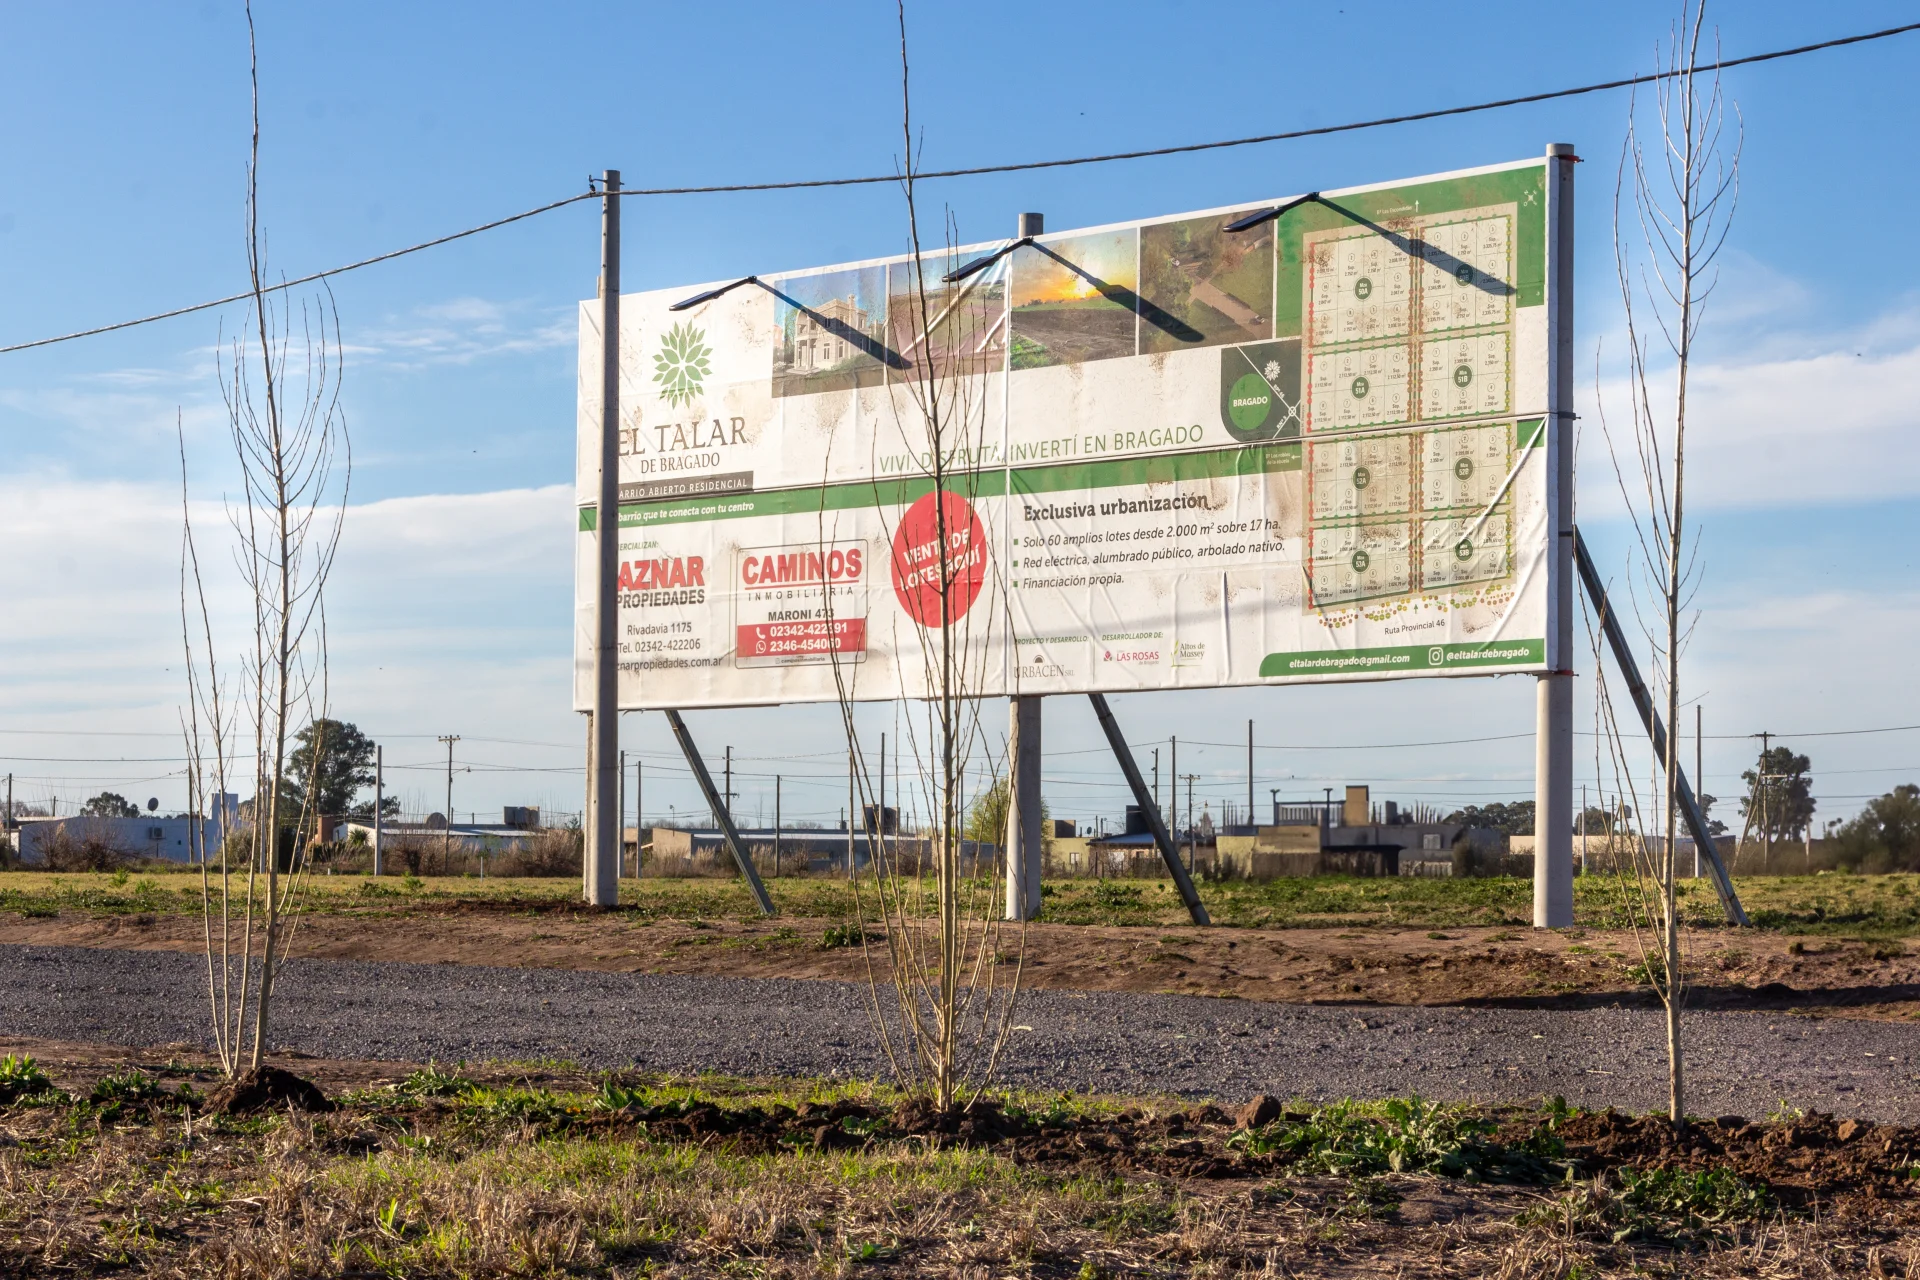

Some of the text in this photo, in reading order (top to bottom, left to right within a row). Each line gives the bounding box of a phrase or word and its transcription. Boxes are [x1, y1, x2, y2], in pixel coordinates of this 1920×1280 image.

[1233, 396, 1268, 408] BRAGADO
[618, 416, 748, 457] EL TALAR
[880, 424, 1203, 472] VIVÍ, DSFRUTÁ, INVERTÍ EN BRAGADO
[641, 452, 720, 474] DE BRAGADO
[619, 478, 748, 499] ARRIO ABIERTO RESIDENCIAL
[618, 502, 754, 524] barrio que te conecta con tu centro
[1024, 492, 1210, 522] Exclusiva urbanización
[1023, 518, 1281, 549] Solo 60 amplios lotes desde 2.000 m² sobre 17 ha.
[618, 540, 659, 550] ERCIALIZAN:
[903, 528, 970, 566] VENT DE
[1023, 540, 1285, 570] Red eléctrica, alumbrado público, arbolado nativo.
[618, 556, 705, 592] AZNAR
[742, 548, 862, 584] CAMINOS
[901, 564, 942, 592] LOTES
[1023, 572, 1124, 590] Financiación propia.
[618, 589, 706, 608] PROPIEDADES
[748, 586, 854, 601] INMOBILIARIA
[768, 608, 834, 622] MARONI 473
[628, 622, 692, 636] Rivadavia 1175
[1384, 618, 1445, 635] Ruta Provincial 46
[618, 638, 700, 653] Tel. 02342-422206
[1102, 632, 1152, 641] DESARROLLADOR
[1198, 642, 1205, 650] de
[1446, 647, 1530, 662] @eltalardebragado
[1116, 651, 1160, 662] LAS ROSAS
[1289, 653, 1410, 668] eltalardebragado@gmail.com
[1014, 665, 1064, 678] URBACEN
